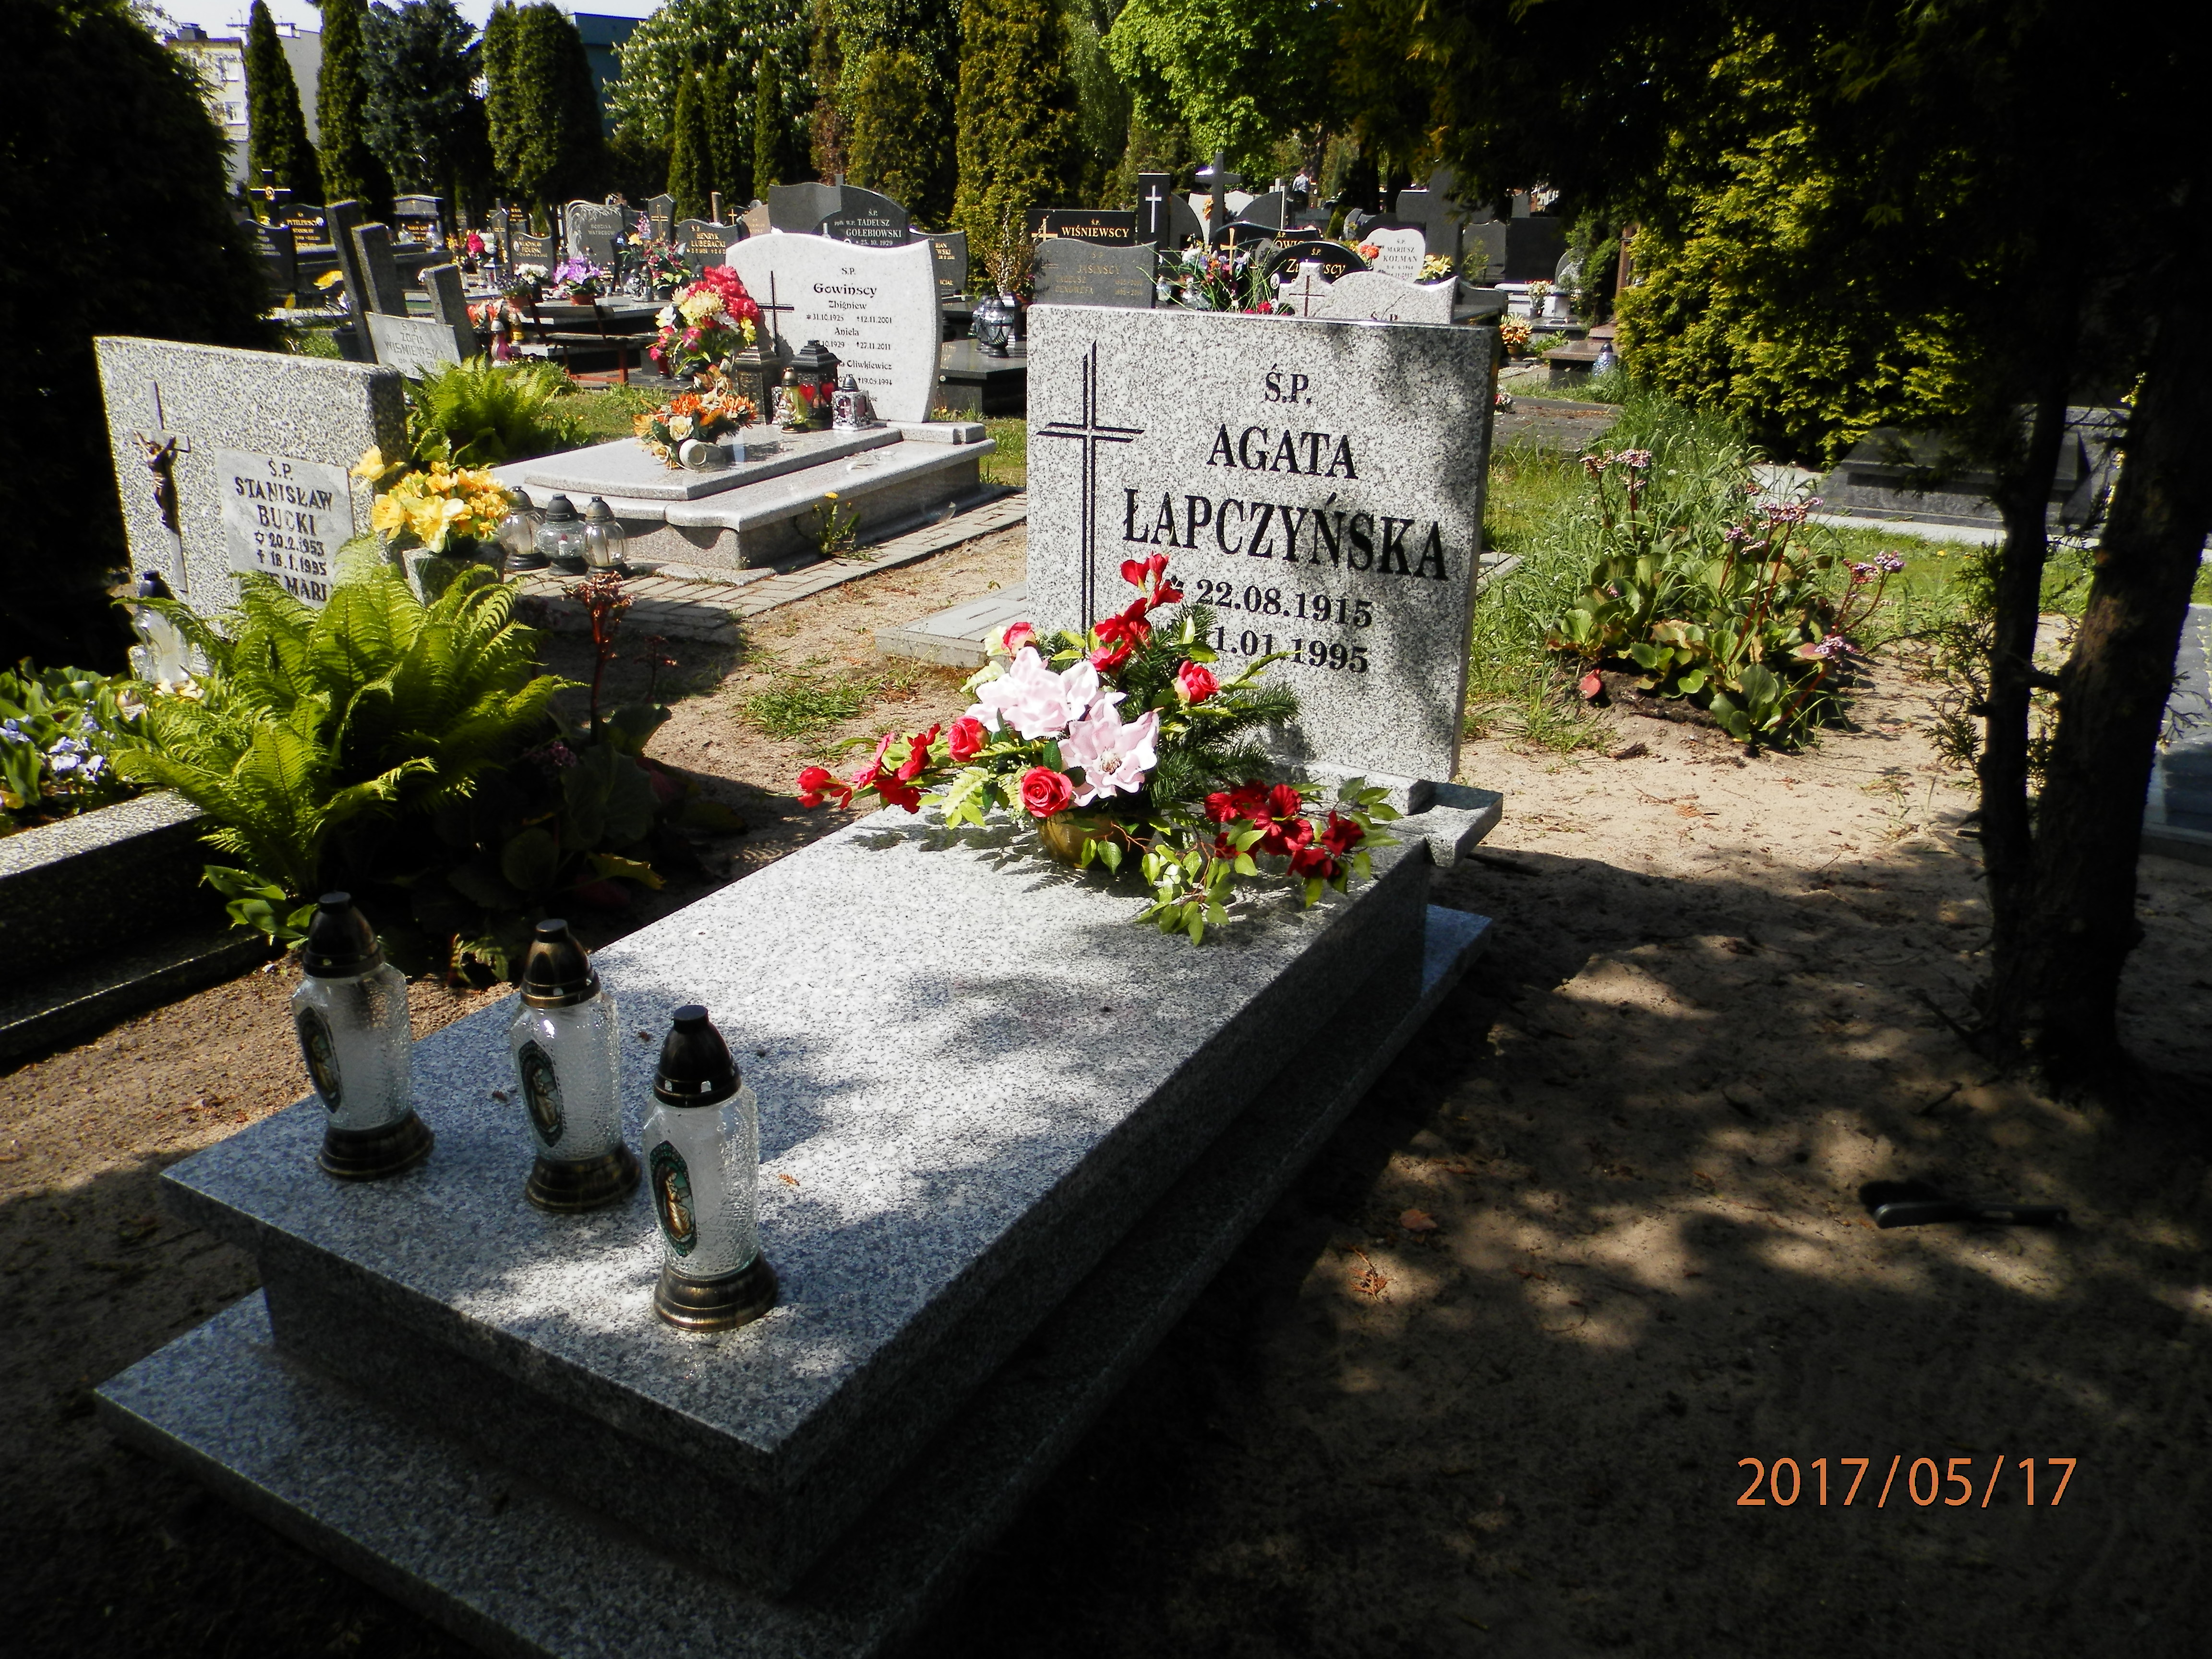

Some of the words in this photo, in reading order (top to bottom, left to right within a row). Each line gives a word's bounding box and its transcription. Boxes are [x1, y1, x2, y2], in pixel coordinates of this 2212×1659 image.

[857, 218, 890, 227] TADEUSZ
[1061, 225, 1130, 238] WIŚNIEWSCY
[813, 283, 877, 298] Gowińscy
[829, 300, 867, 311] Zbigniew
[834, 327, 859, 336] Aniela
[861, 316, 892, 324] 12.11.2001
[400, 332, 425, 345] ZOFIA
[860, 342, 891, 350] 27.11.2011
[846, 360, 892, 370] Oliwkiewicz
[1264, 363, 1312, 405] Ś.P.
[1206, 422, 1359, 480] AGATA
[268, 457, 293, 481] Ś.P.
[234, 476, 333, 512] STANISŁAW
[257, 504, 317, 537] BUCKI
[268, 532, 325, 557] 20.2.1953
[1122, 487, 1450, 581] ŁAPCZYŃSKA
[270, 551, 327, 576] 18.1.1995
[284, 575, 334, 602] MARI
[1195, 578, 1373, 628] 22.08.1915
[1213, 626, 1369, 673] 1.01.1995
